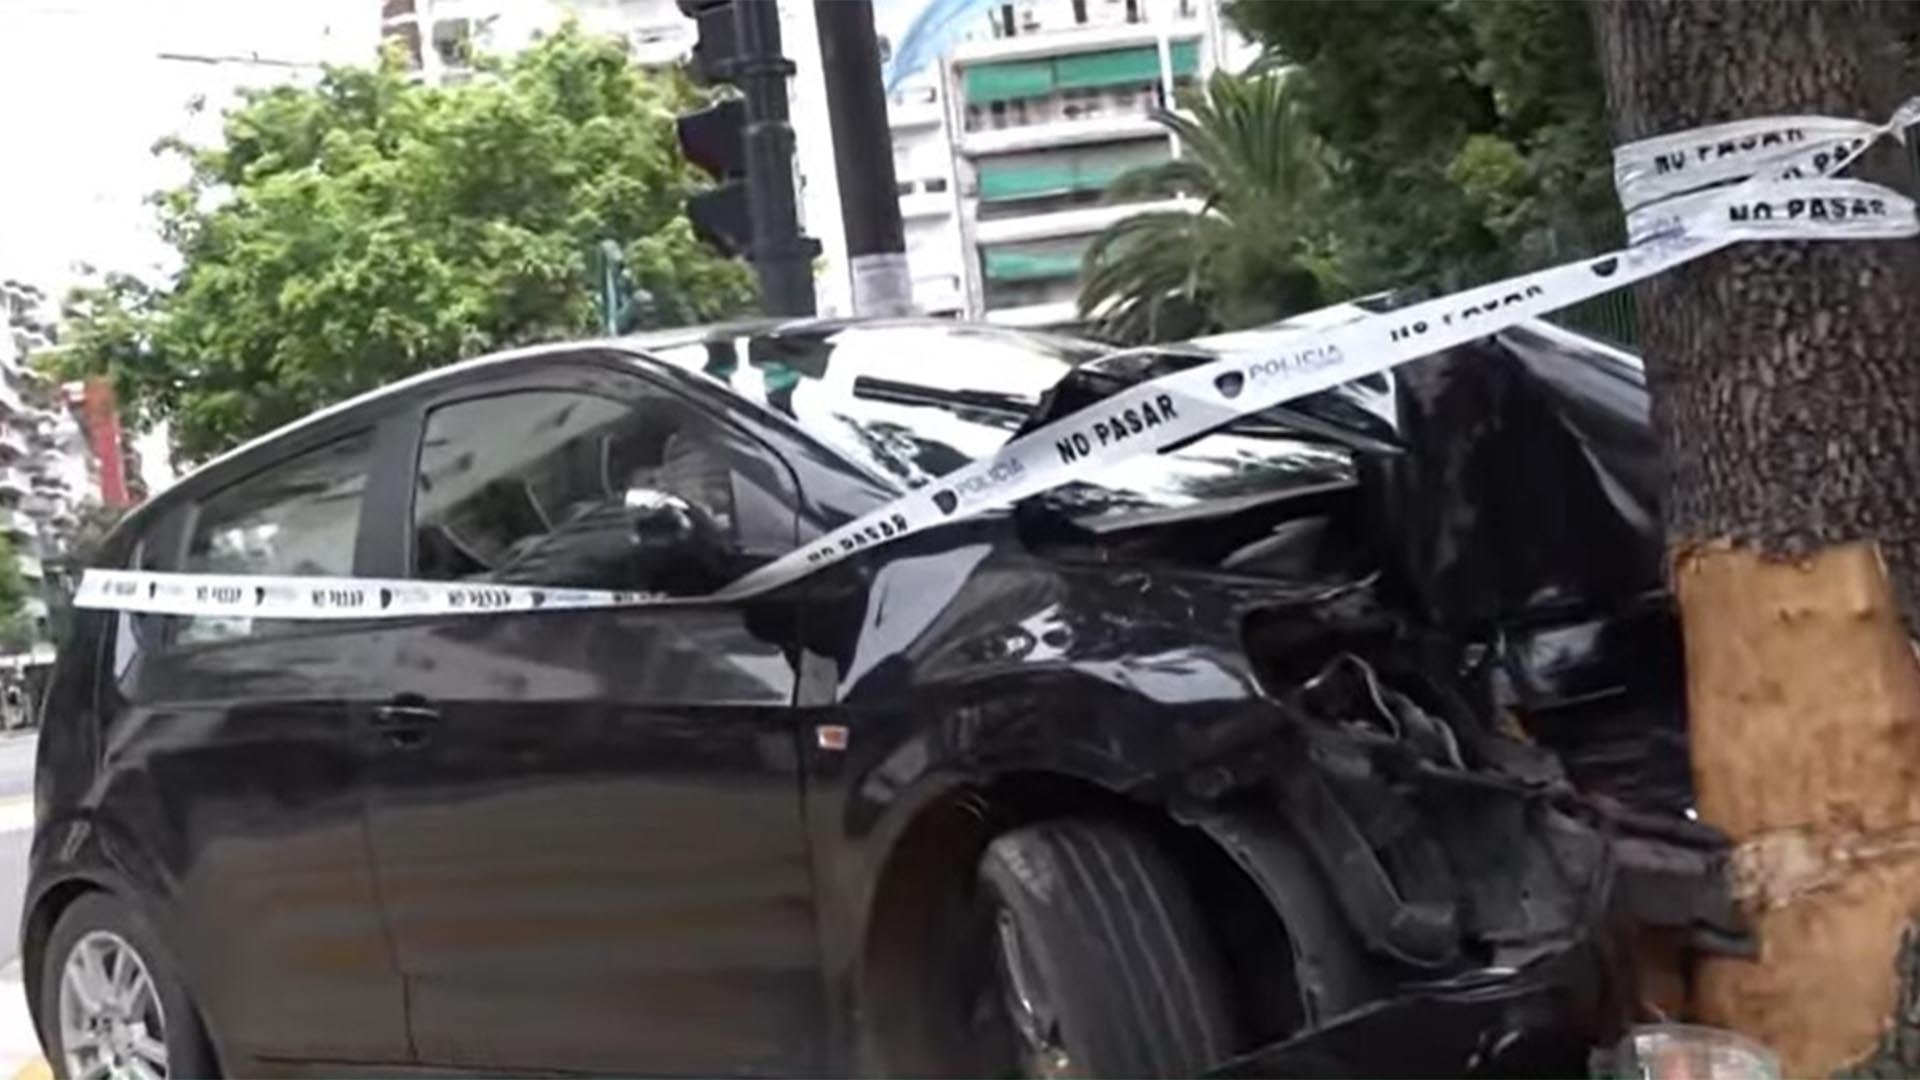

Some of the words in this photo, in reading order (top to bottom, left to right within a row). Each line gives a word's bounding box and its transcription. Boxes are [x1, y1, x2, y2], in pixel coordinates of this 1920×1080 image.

[1729, 200, 1772, 222] NO
[1786, 197, 1886, 222] PASAR
[839, 513, 908, 551] PASAR
[1054, 436, 1091, 465] NO
[1093, 393, 1179, 448] PASAR
